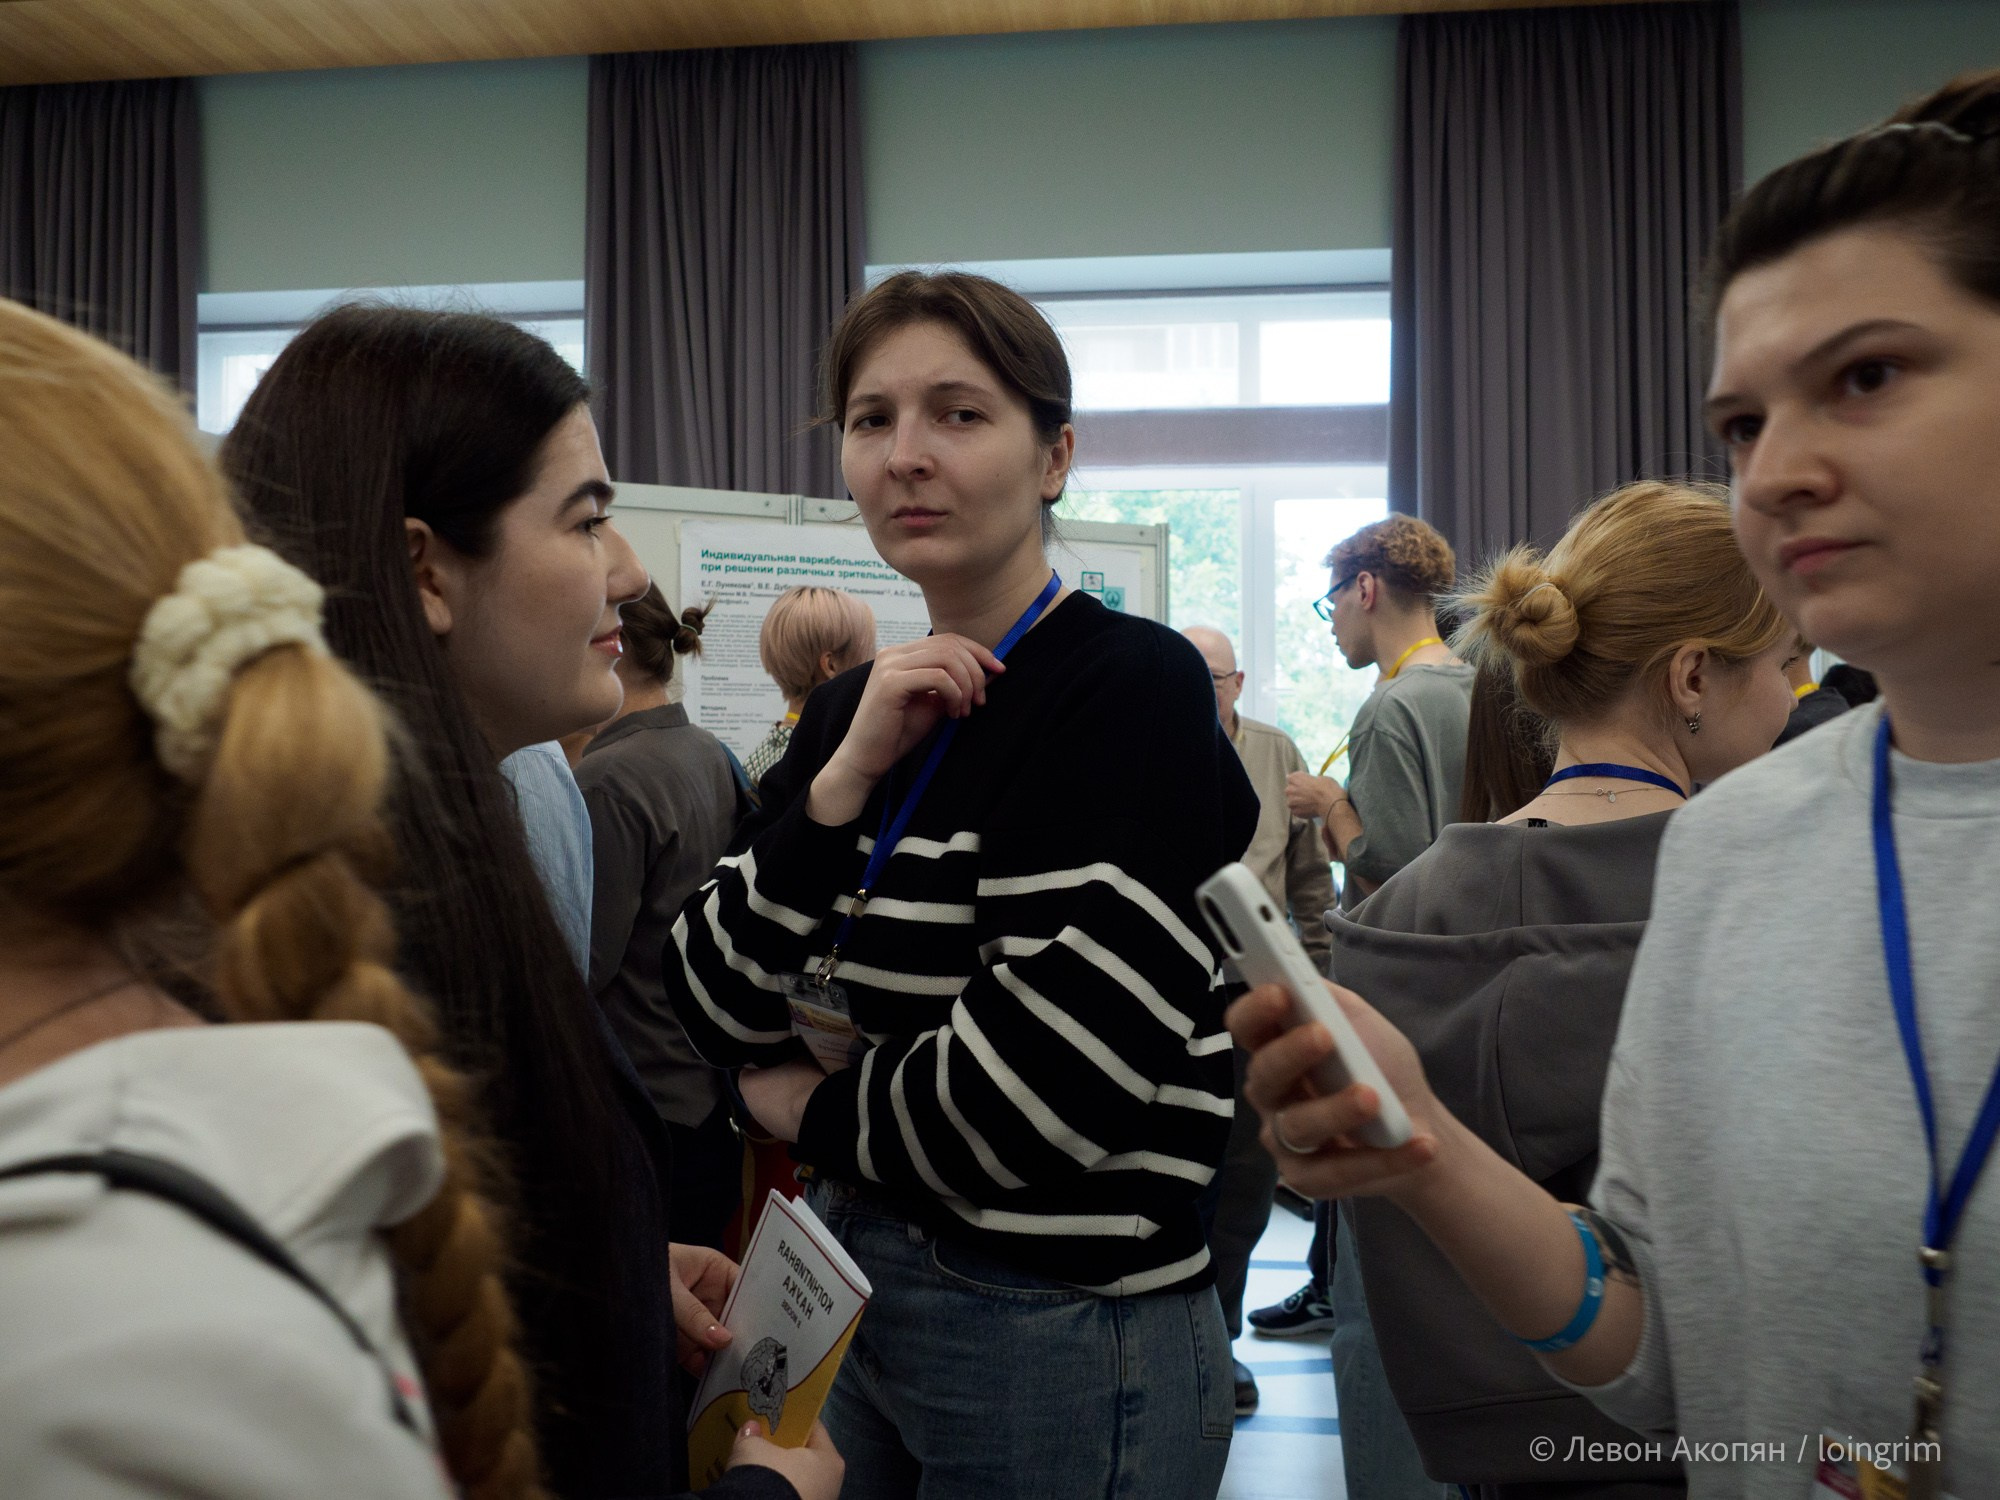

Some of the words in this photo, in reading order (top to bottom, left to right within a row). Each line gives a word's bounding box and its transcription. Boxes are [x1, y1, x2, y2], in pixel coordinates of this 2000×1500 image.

[701, 549, 796, 563] Индивидуальная
[799, 556, 883, 568] вариабельность
[701, 563, 721, 572] при
[724, 564, 773, 574] решении
[777, 566, 835, 576] различных
[838, 569, 898, 580] зрительных
